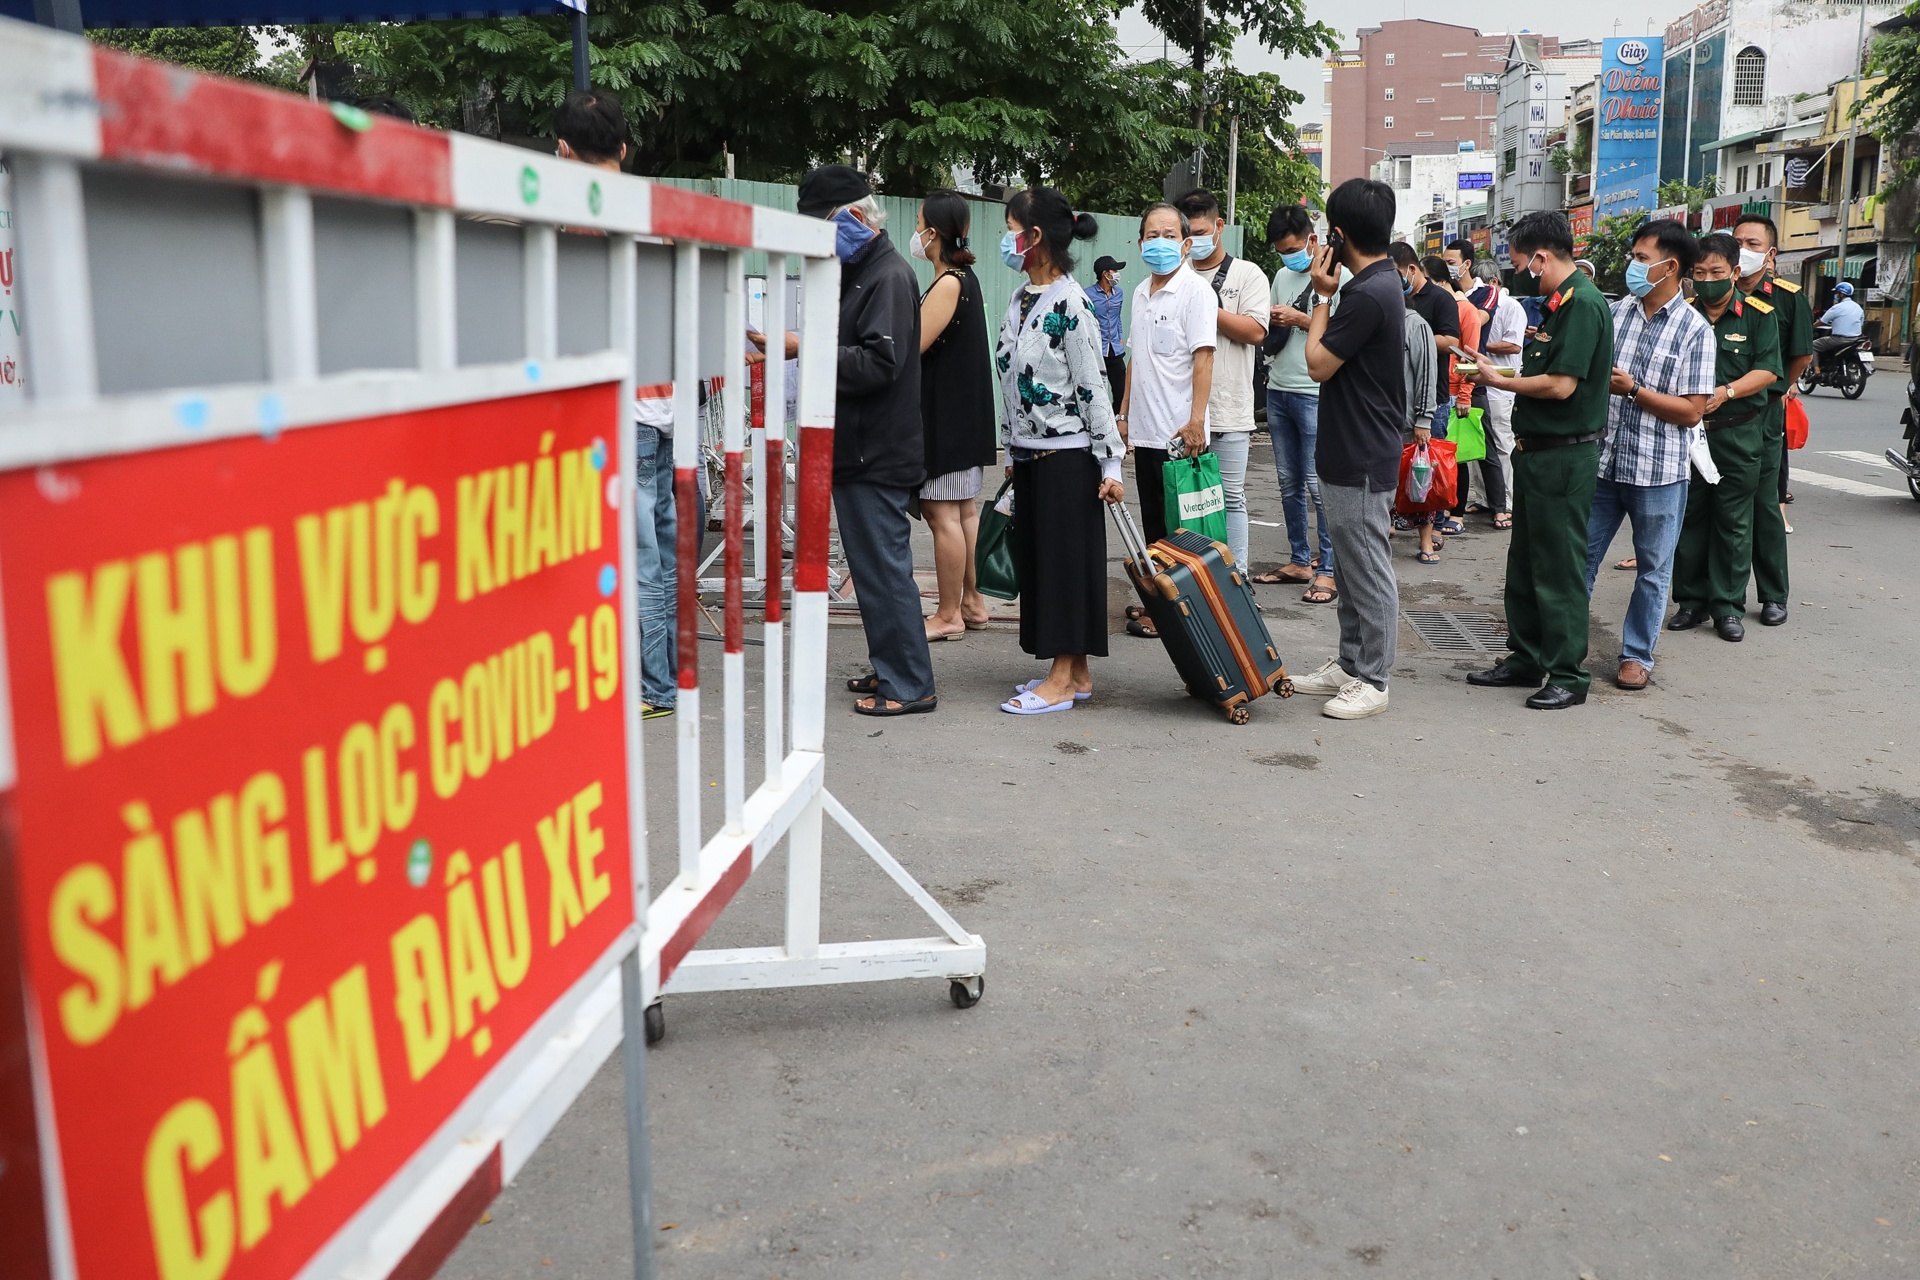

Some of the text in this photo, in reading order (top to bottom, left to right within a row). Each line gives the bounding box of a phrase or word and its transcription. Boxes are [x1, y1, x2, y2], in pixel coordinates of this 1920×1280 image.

[1621, 43, 1647, 61] Giày
[1602, 65, 1660, 92] Diễm
[1530, 103, 1544, 121] NHÀ
[1601, 96, 1660, 124] Phúc
[49, 431, 603, 765] KHU VỰC KHÁM
[51, 603, 619, 1044] SÀNG LỌC COVID-19
[143, 781, 612, 1280] CẤM ĐẬU XE
